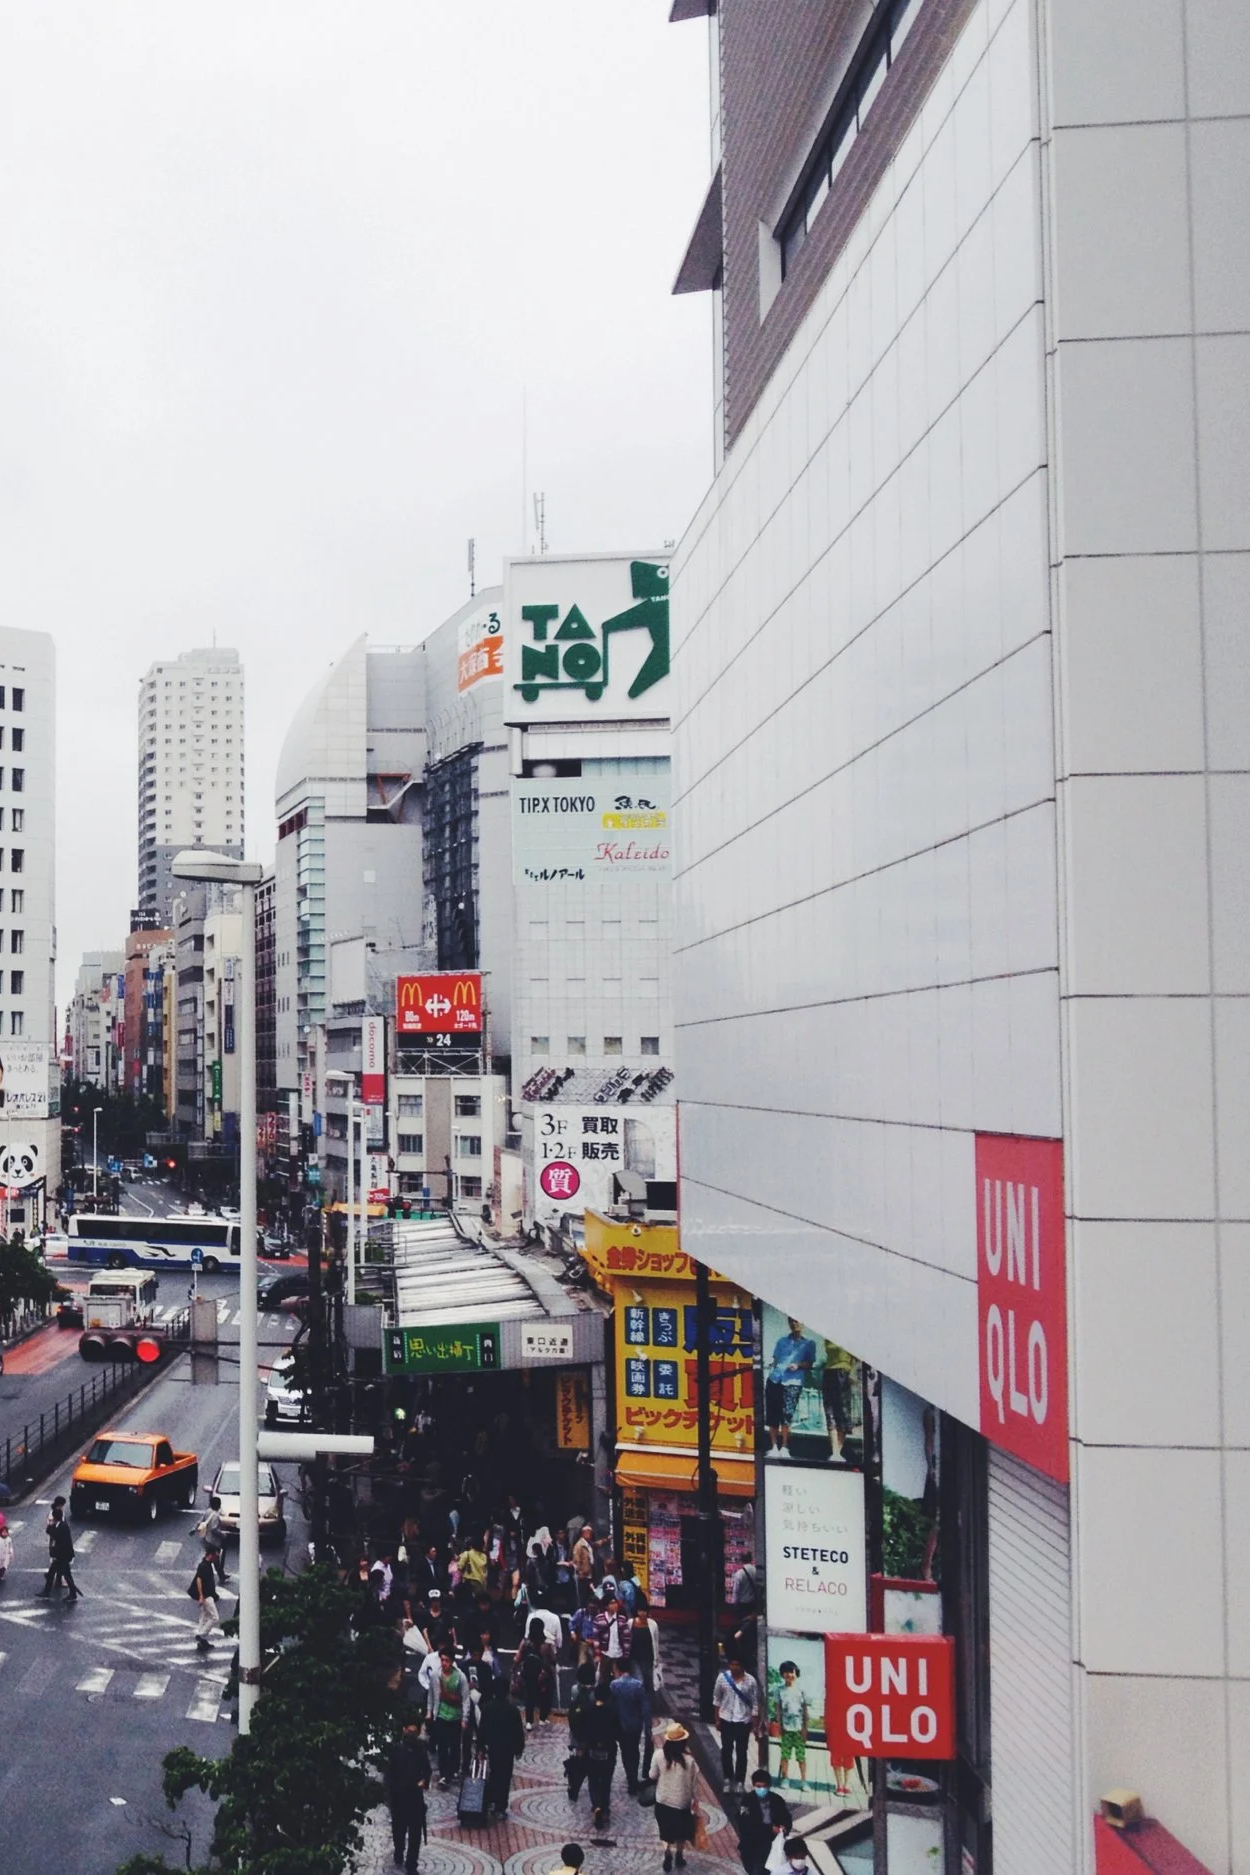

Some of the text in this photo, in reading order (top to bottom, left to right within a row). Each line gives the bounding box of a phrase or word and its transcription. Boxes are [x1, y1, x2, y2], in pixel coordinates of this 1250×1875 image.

[521, 603, 597, 640] TA
[521, 642, 602, 681] NO
[519, 795, 596, 814] TIP.X TOKYO
[594, 841, 670, 866] Kaleido
[369, 1022, 377, 1068] docomo
[436, 1034, 452, 1046] 24
[540, 1113, 619, 1136] 3F 買取
[581, 1142, 620, 1160] 販売
[548, 1168, 573, 1194] 質
[984, 1177, 1041, 1291] UNI
[629, 1308, 645, 1343] 新幹線
[657, 1311, 673, 1343] きっぷ
[408, 1337, 474, 1361] 思い出横丁
[986, 1302, 1048, 1426] QLO
[629, 1360, 646, 1395] 映画券
[658, 1363, 674, 1396] 委託
[782, 1484, 807, 1497] 軽い
[782, 1502, 821, 1515] 涼しい
[782, 1519, 849, 1534] 気持ちいい
[782, 1545, 849, 1564] STETECO
[811, 1566, 820, 1576] &
[784, 1577, 849, 1597] RELACO
[845, 1655, 929, 1695] UNI
[846, 1704, 938, 1749] QLO
